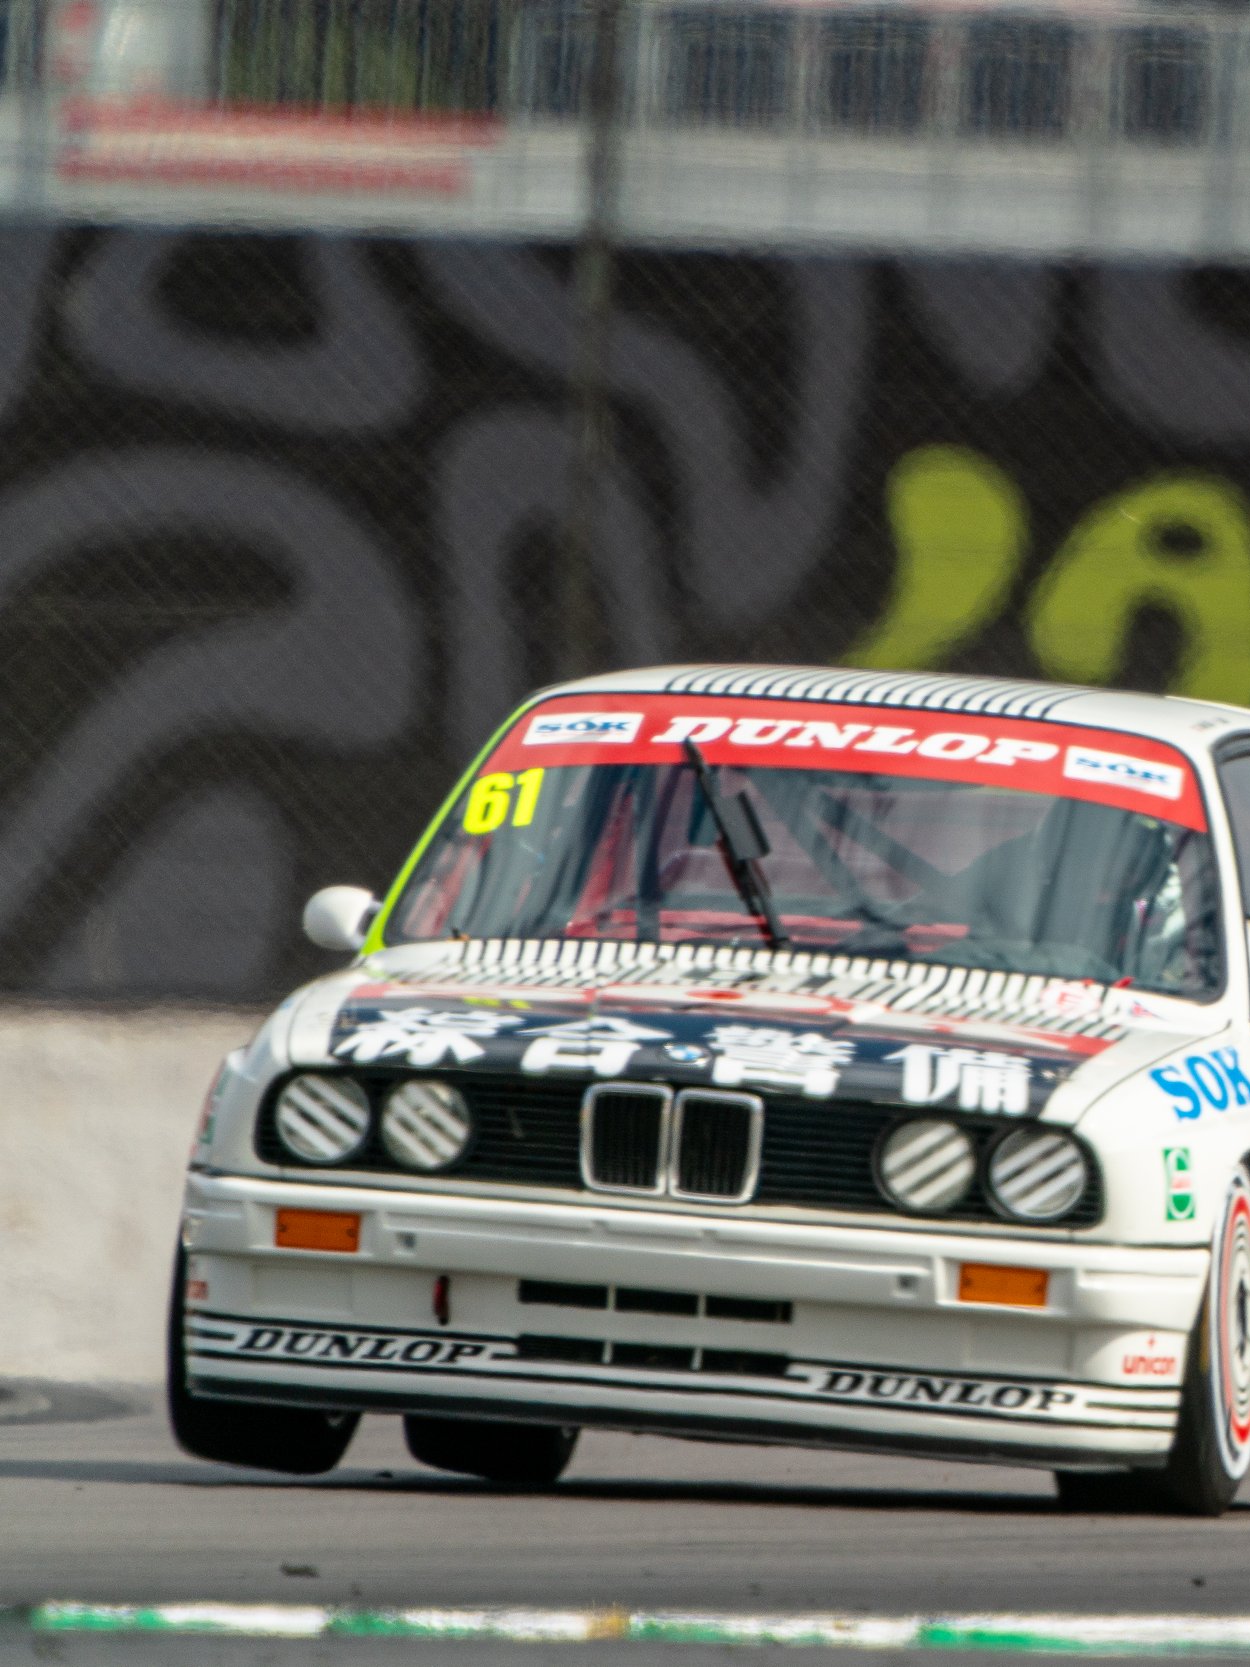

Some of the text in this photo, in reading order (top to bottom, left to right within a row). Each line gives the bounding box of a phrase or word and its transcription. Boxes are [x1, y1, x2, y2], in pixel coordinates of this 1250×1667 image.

[650, 716, 1059, 766] DUNLOP
[462, 767, 545, 835] 61
[237, 1327, 488, 1365] DUNLOP
[818, 1369, 1078, 1411] DUNLOP
